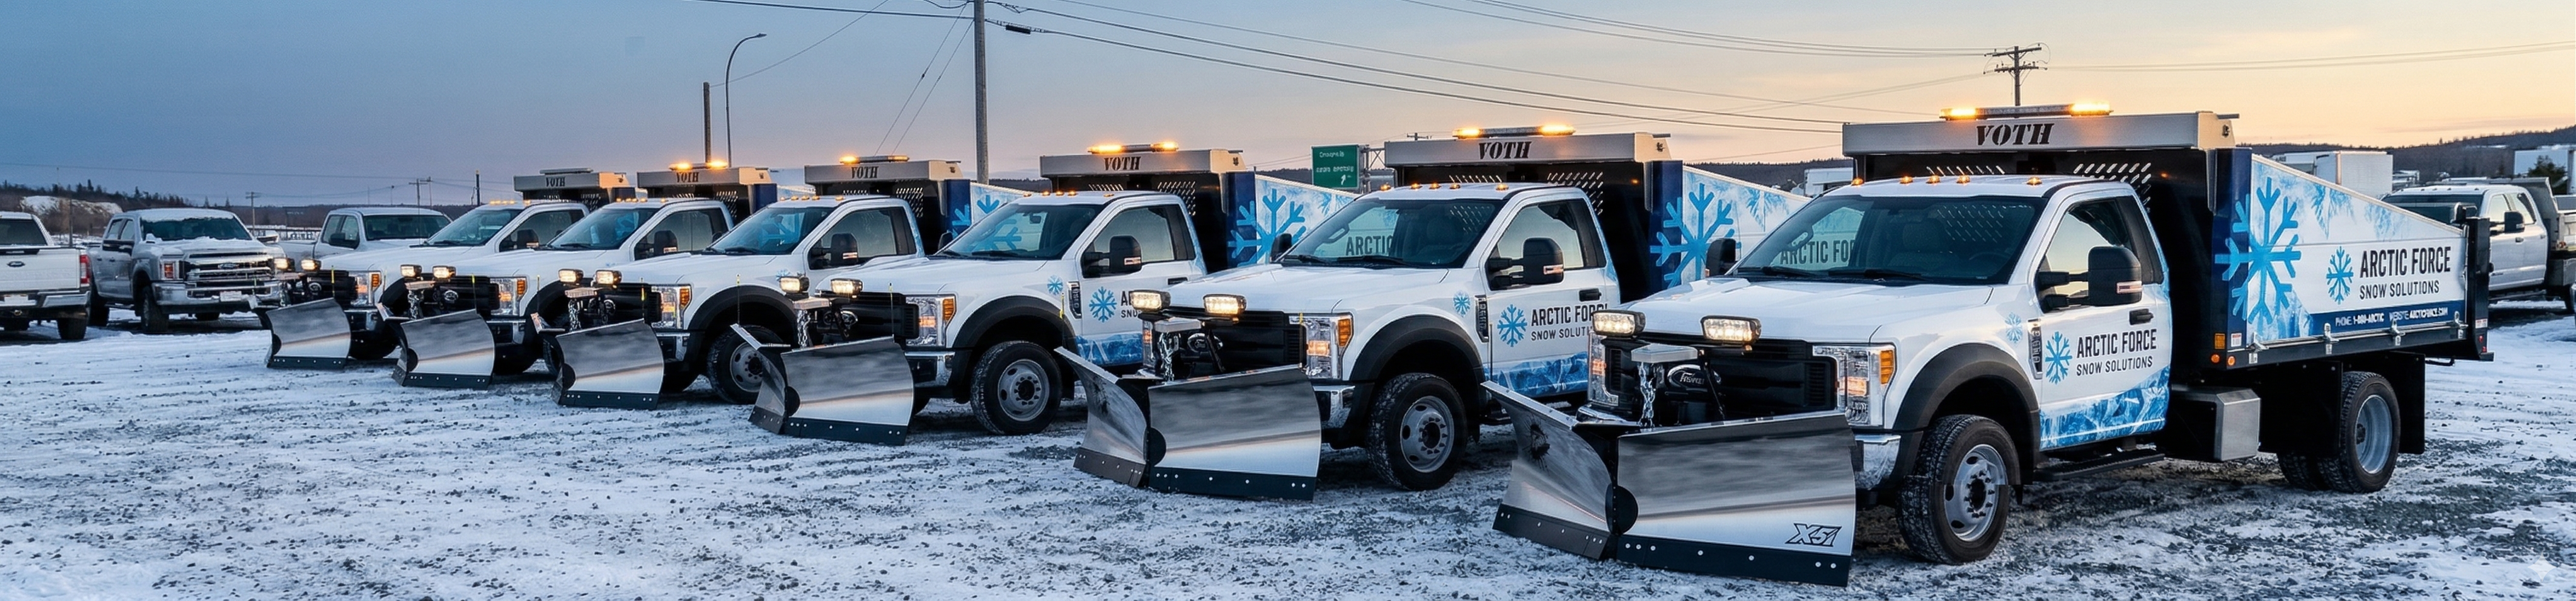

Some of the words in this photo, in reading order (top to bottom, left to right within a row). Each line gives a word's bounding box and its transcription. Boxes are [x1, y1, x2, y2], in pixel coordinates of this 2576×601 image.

[1976, 123, 2054, 145] VOTH
[1479, 141, 1532, 159] VOTH
[851, 166, 879, 179] VOTH
[1104, 156, 1141, 170] VOTH
[546, 177, 565, 187] VOTH
[676, 171, 699, 182] VOTH
[2360, 248, 2407, 278] ARCTIC
[2411, 246, 2451, 274] FORCE
[2360, 284, 2387, 300] SNOW
[2389, 279, 2439, 297] SOLUTIONS
[1531, 306, 1571, 327] ARCTIC
[1575, 303, 1608, 322] FOR
[1531, 330, 1556, 341] SNOW
[2077, 333, 2118, 358] ARCTIC
[2122, 328, 2157, 353] FORCE
[2076, 362, 2102, 376] SNOW
[2105, 356, 2153, 373] SOLUTIONS
